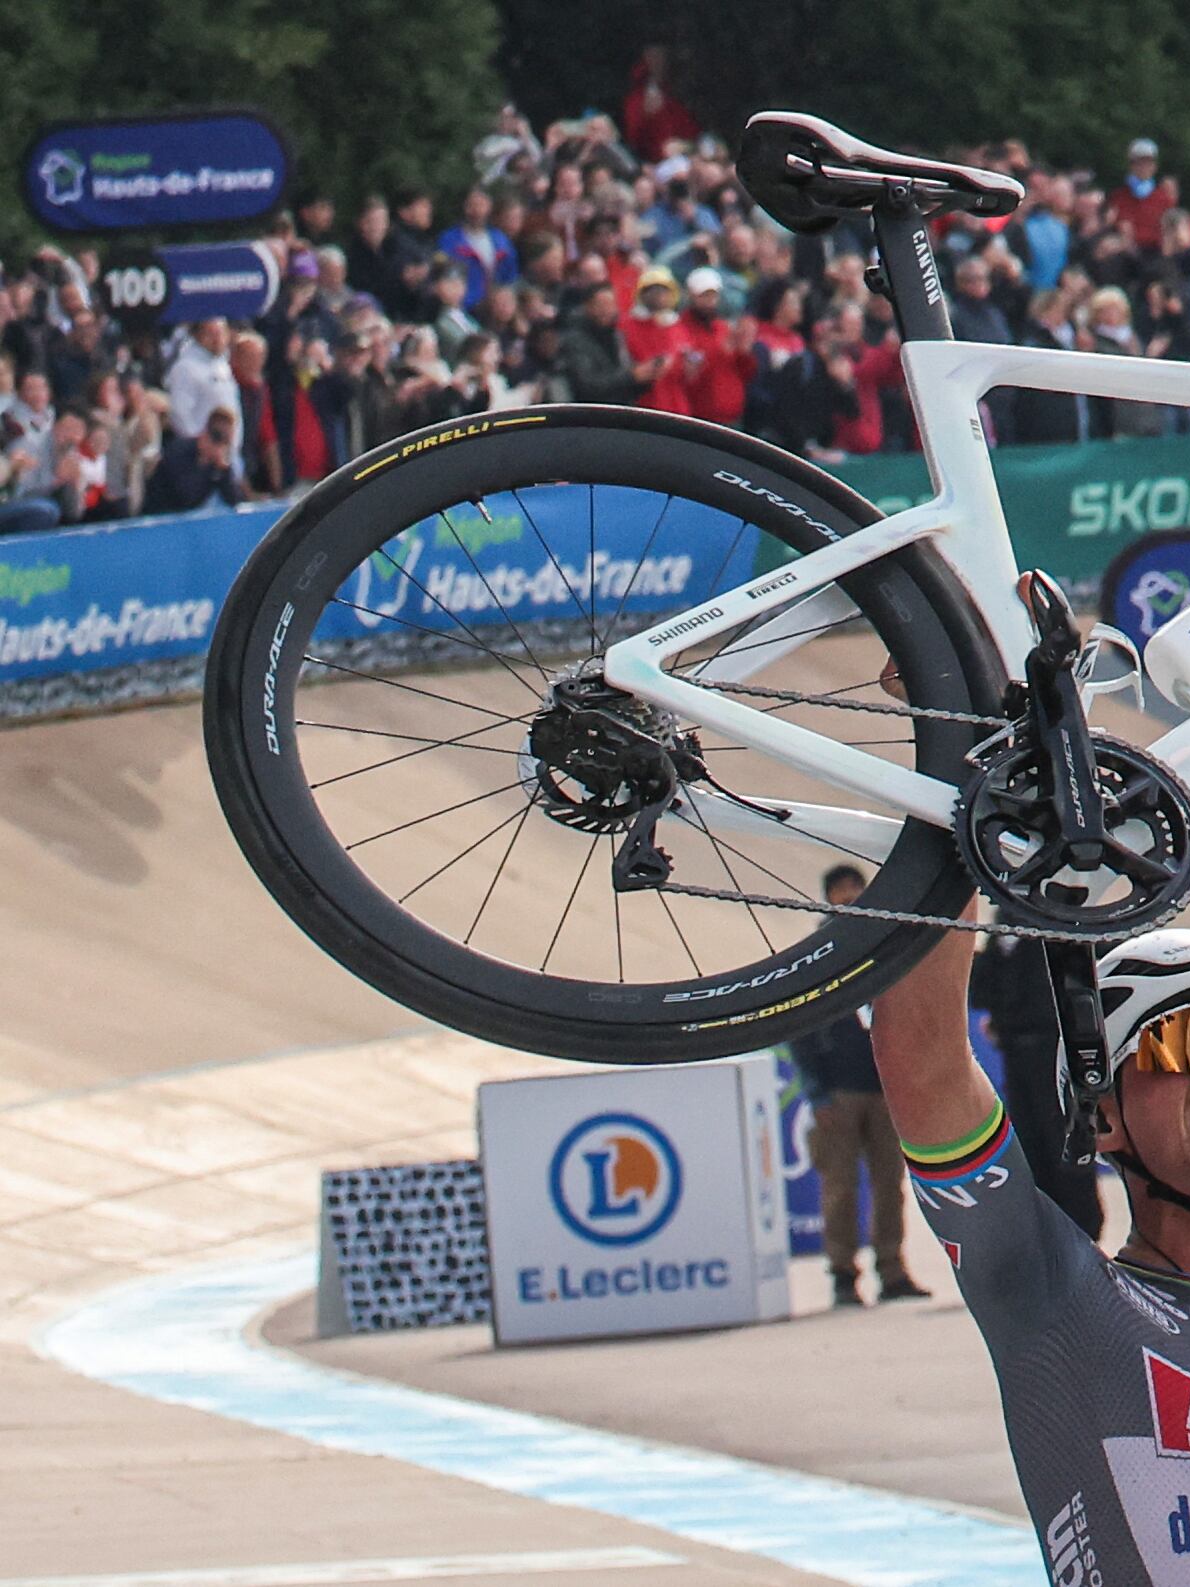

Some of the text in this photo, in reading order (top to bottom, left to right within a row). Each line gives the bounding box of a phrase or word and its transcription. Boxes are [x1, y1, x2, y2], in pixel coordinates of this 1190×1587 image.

[104, 266, 166, 308] 100
[912, 229, 942, 307] CANYON
[402, 423, 489, 457] PIRELLI
[713, 470, 844, 543] DURA-A
[424, 552, 693, 613] Hauts-de-France
[746, 571, 798, 600] PIRELLI
[647, 606, 725, 647] SHIMANO
[263, 602, 295, 756] DURA-ACE
[662, 940, 835, 1004] DURA-ACE
[758, 987, 823, 1019] ZERO
[518, 1256, 731, 1304] E.Leclerc
